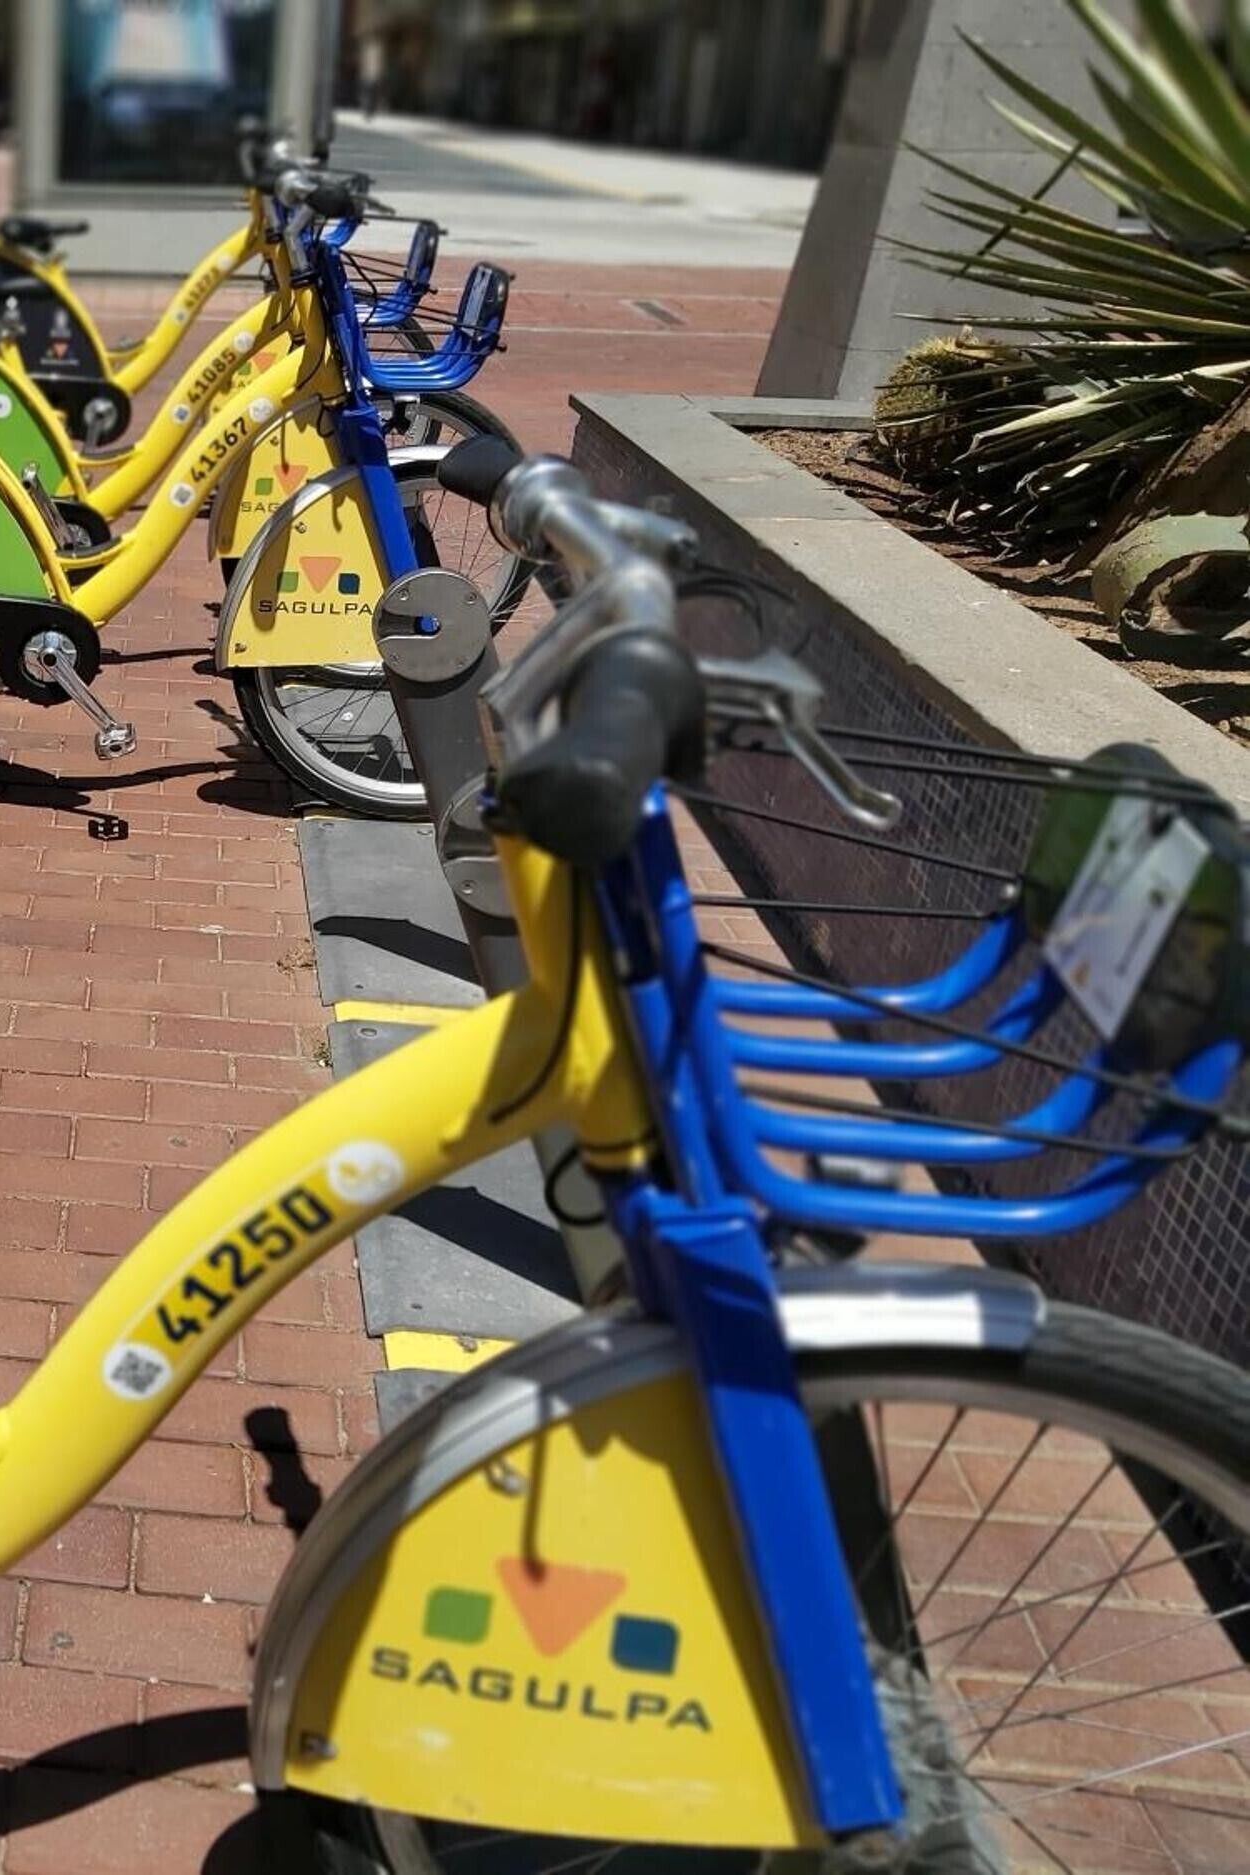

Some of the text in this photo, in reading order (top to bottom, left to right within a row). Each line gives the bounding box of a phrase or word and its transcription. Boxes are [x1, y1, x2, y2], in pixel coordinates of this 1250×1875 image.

[187, 350, 236, 402] 41085
[191, 417, 249, 482] 41367
[258, 600, 374, 616] SAGULPA
[157, 1186, 333, 1343] 41250
[369, 1647, 712, 1733] SAGULPA
